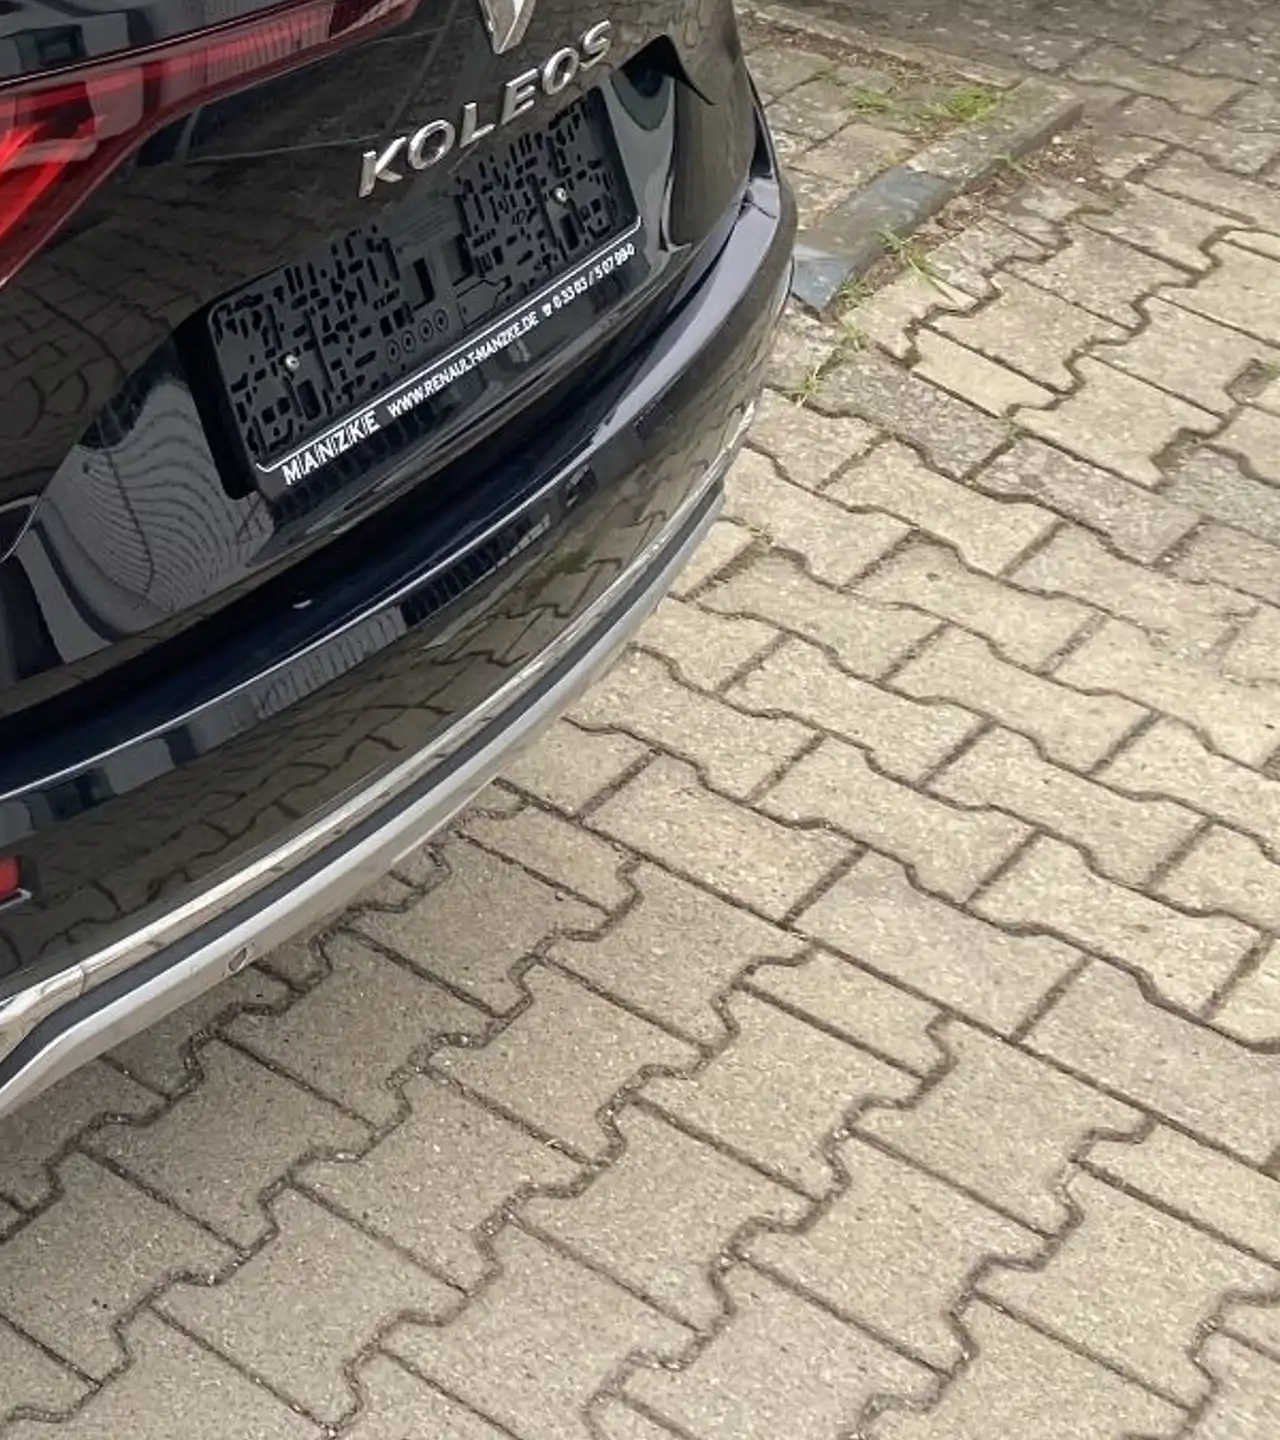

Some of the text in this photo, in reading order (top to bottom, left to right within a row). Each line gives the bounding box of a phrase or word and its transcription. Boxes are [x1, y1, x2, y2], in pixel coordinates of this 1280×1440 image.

[358, 19, 612, 198] KOLEOS
[282, 410, 381, 485] MANZKE
[387, 310, 540, 418] WWW.RENAULT-MANZKE.DE
